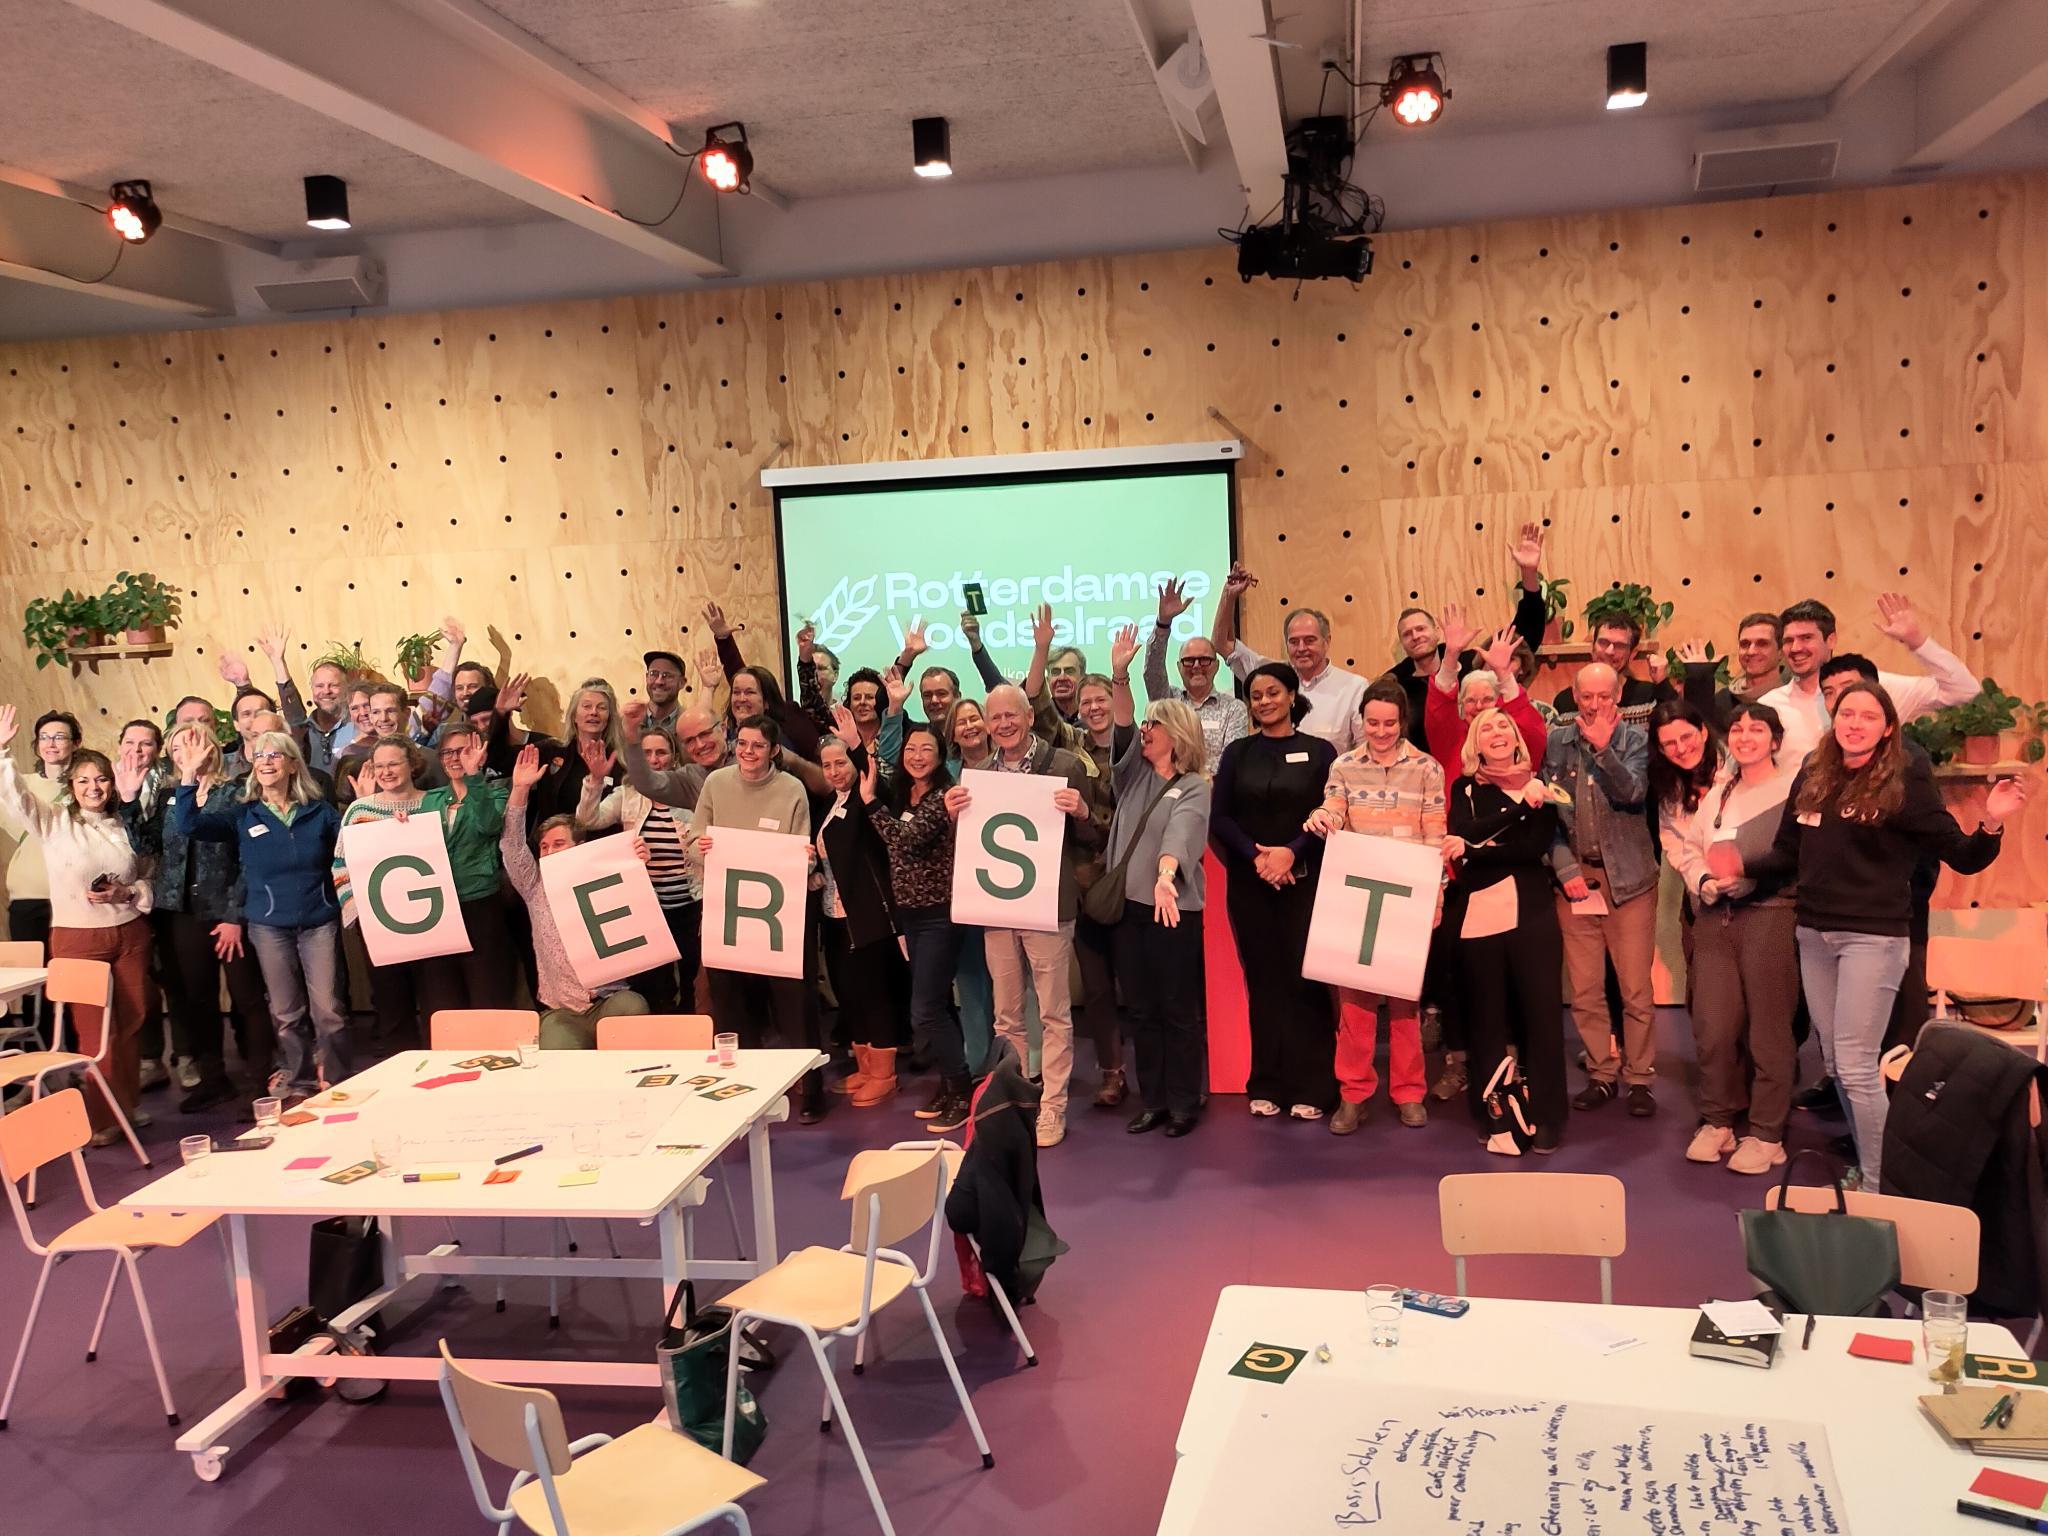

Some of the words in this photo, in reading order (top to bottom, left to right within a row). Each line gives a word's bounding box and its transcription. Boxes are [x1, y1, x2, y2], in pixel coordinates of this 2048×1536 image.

[884, 564, 1211, 610] Rotterdamse
[966, 590, 981, 612] T
[367, 854, 445, 935] G
[975, 812, 1039, 901] S
[573, 872, 649, 960] E
[723, 868, 785, 952] R
[1344, 874, 1413, 966] T
[1244, 1348, 1295, 1373] G
[1974, 1355, 2038, 1379] R
